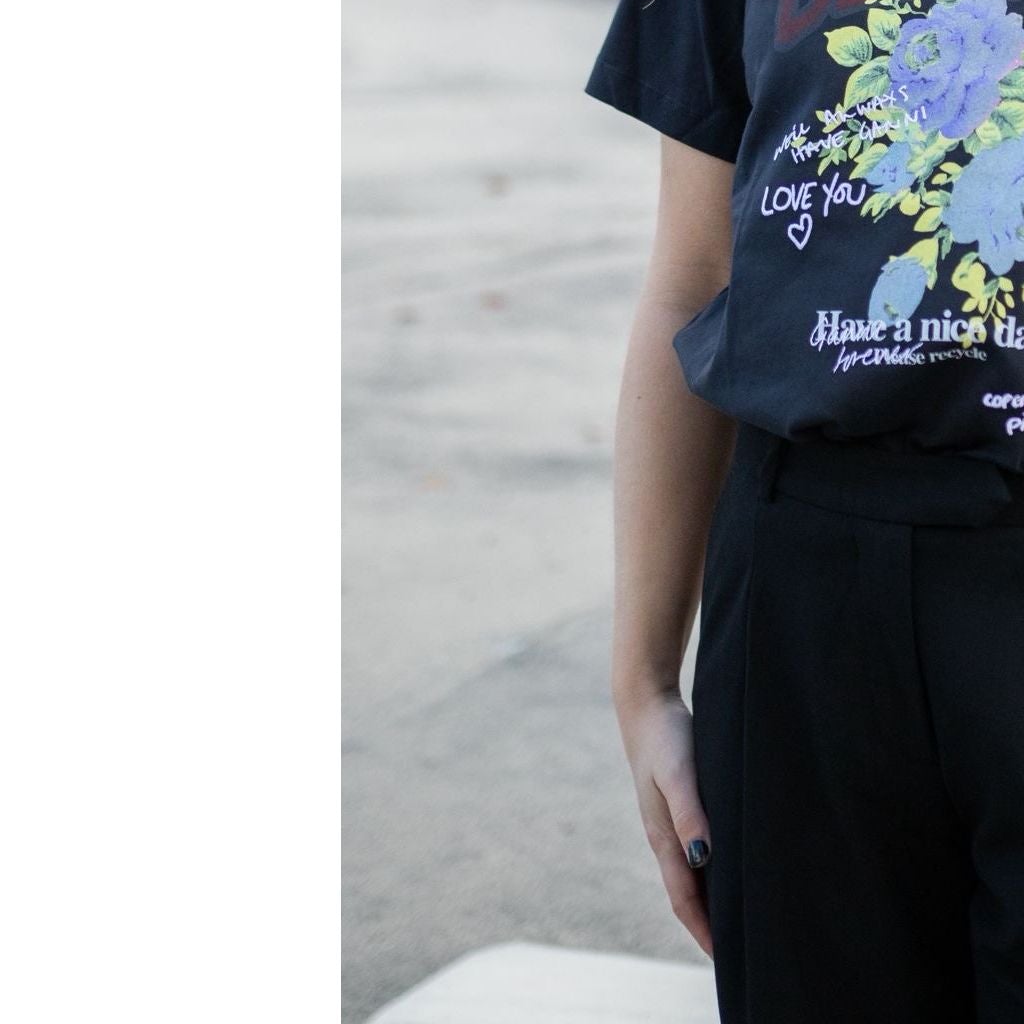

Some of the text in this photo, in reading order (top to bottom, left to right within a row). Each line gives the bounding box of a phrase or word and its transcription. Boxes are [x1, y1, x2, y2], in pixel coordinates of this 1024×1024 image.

[859, 106, 927, 140] GANNI
[761, 172, 866, 217] LOVE YOU
[814, 310, 887, 342] Have
[893, 317, 912, 342] a
[919, 309, 987, 344] nice
[929, 347, 987, 363] recycle
